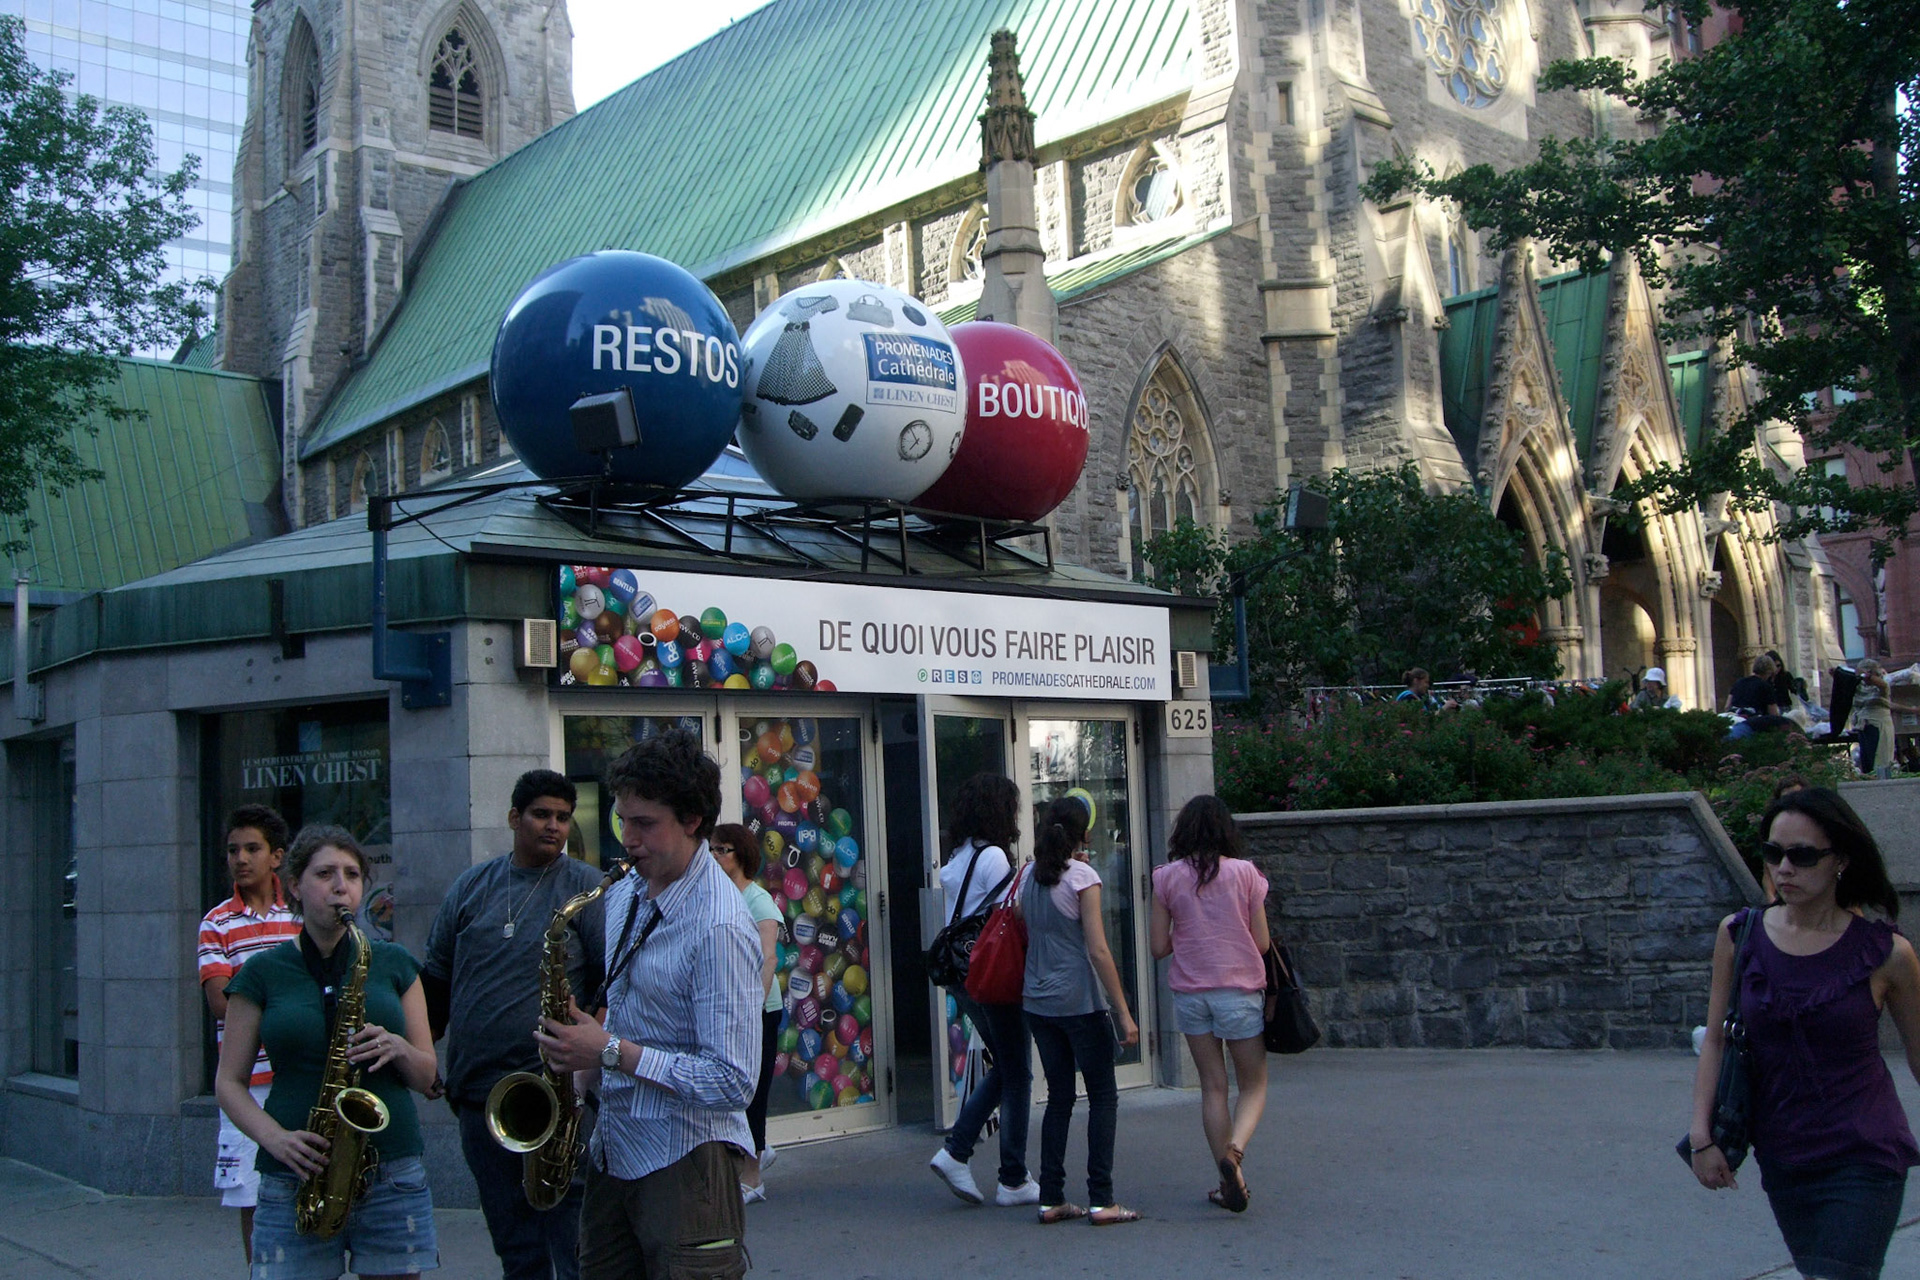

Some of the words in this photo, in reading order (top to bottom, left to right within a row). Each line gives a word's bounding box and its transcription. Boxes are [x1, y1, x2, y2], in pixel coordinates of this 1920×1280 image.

[593, 324, 739, 389] RESTOS
[875, 341, 953, 366] PROMENADES
[878, 358, 955, 385] Cathédrale
[886, 388, 925, 403] LINEN
[926, 393, 955, 408] CHEST
[978, 382, 1090, 433] BOUTIQU
[612, 577, 636, 594] BENTLEY
[726, 631, 749, 645] ALDO
[819, 619, 852, 652] DE
[861, 621, 924, 655] QUOI
[930, 625, 997, 659] VOUS
[1005, 629, 1067, 662] FAIRE
[1074, 634, 1155, 666] PLAISIR
[992, 670, 1156, 690] PROMENADESCATHEDRALE.COM
[1171, 708, 1207, 731] 625
[242, 763, 307, 789] LINEN
[313, 758, 382, 785] CHEST
[798, 829, 817, 843] Bell
[837, 844, 857, 860] ALDO
